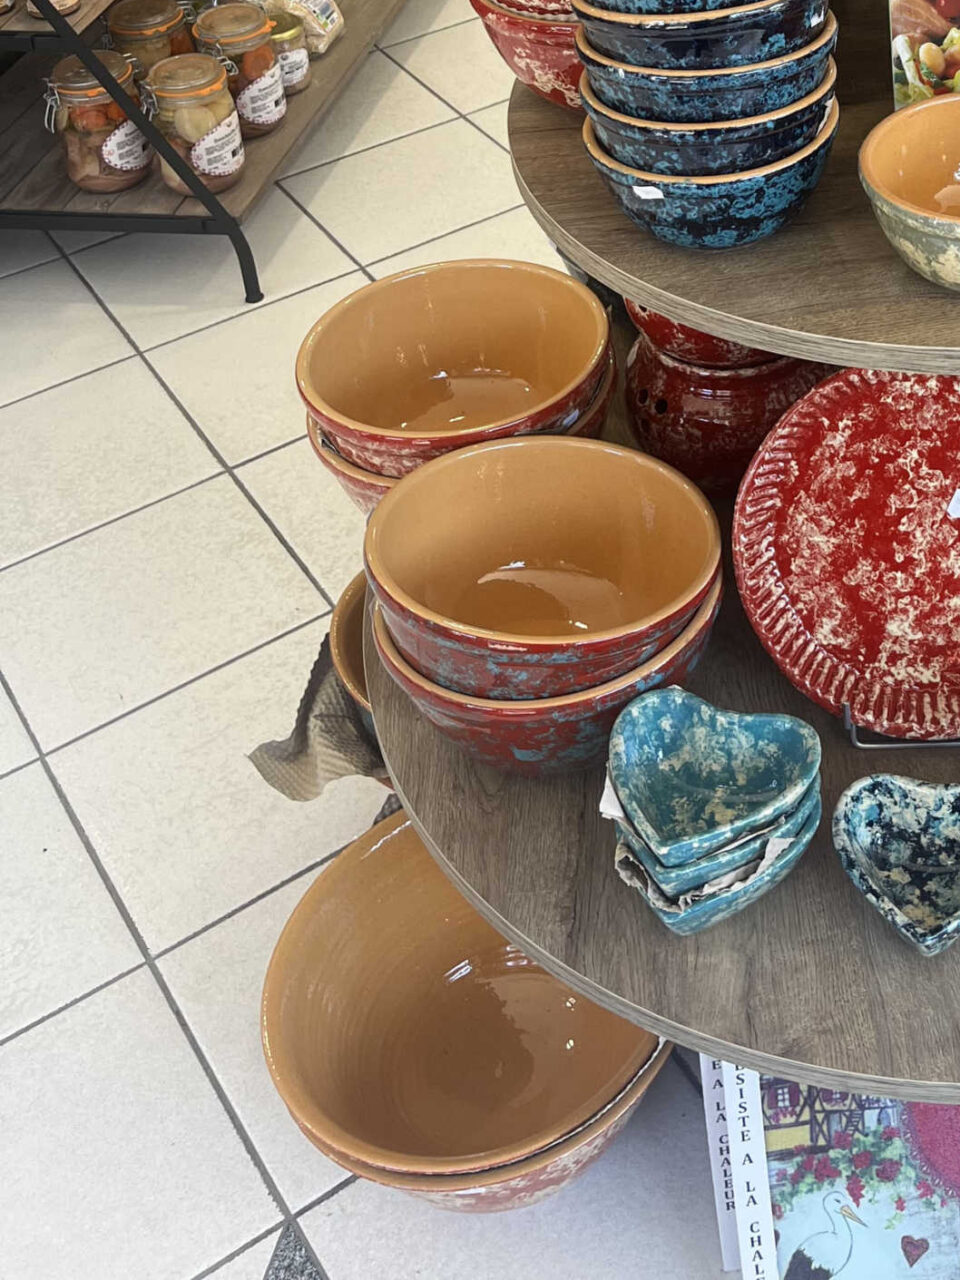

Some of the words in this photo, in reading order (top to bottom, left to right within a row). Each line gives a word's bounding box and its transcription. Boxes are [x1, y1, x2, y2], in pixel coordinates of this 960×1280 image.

[712, 1079, 724, 1090] A
[716, 1101, 727, 1123] LA
[742, 1153, 754, 1166] A
[719, 1134, 736, 1211] CHALEUR
[746, 1181, 758, 1207] LA
[749, 1221, 766, 1280] CHAL
